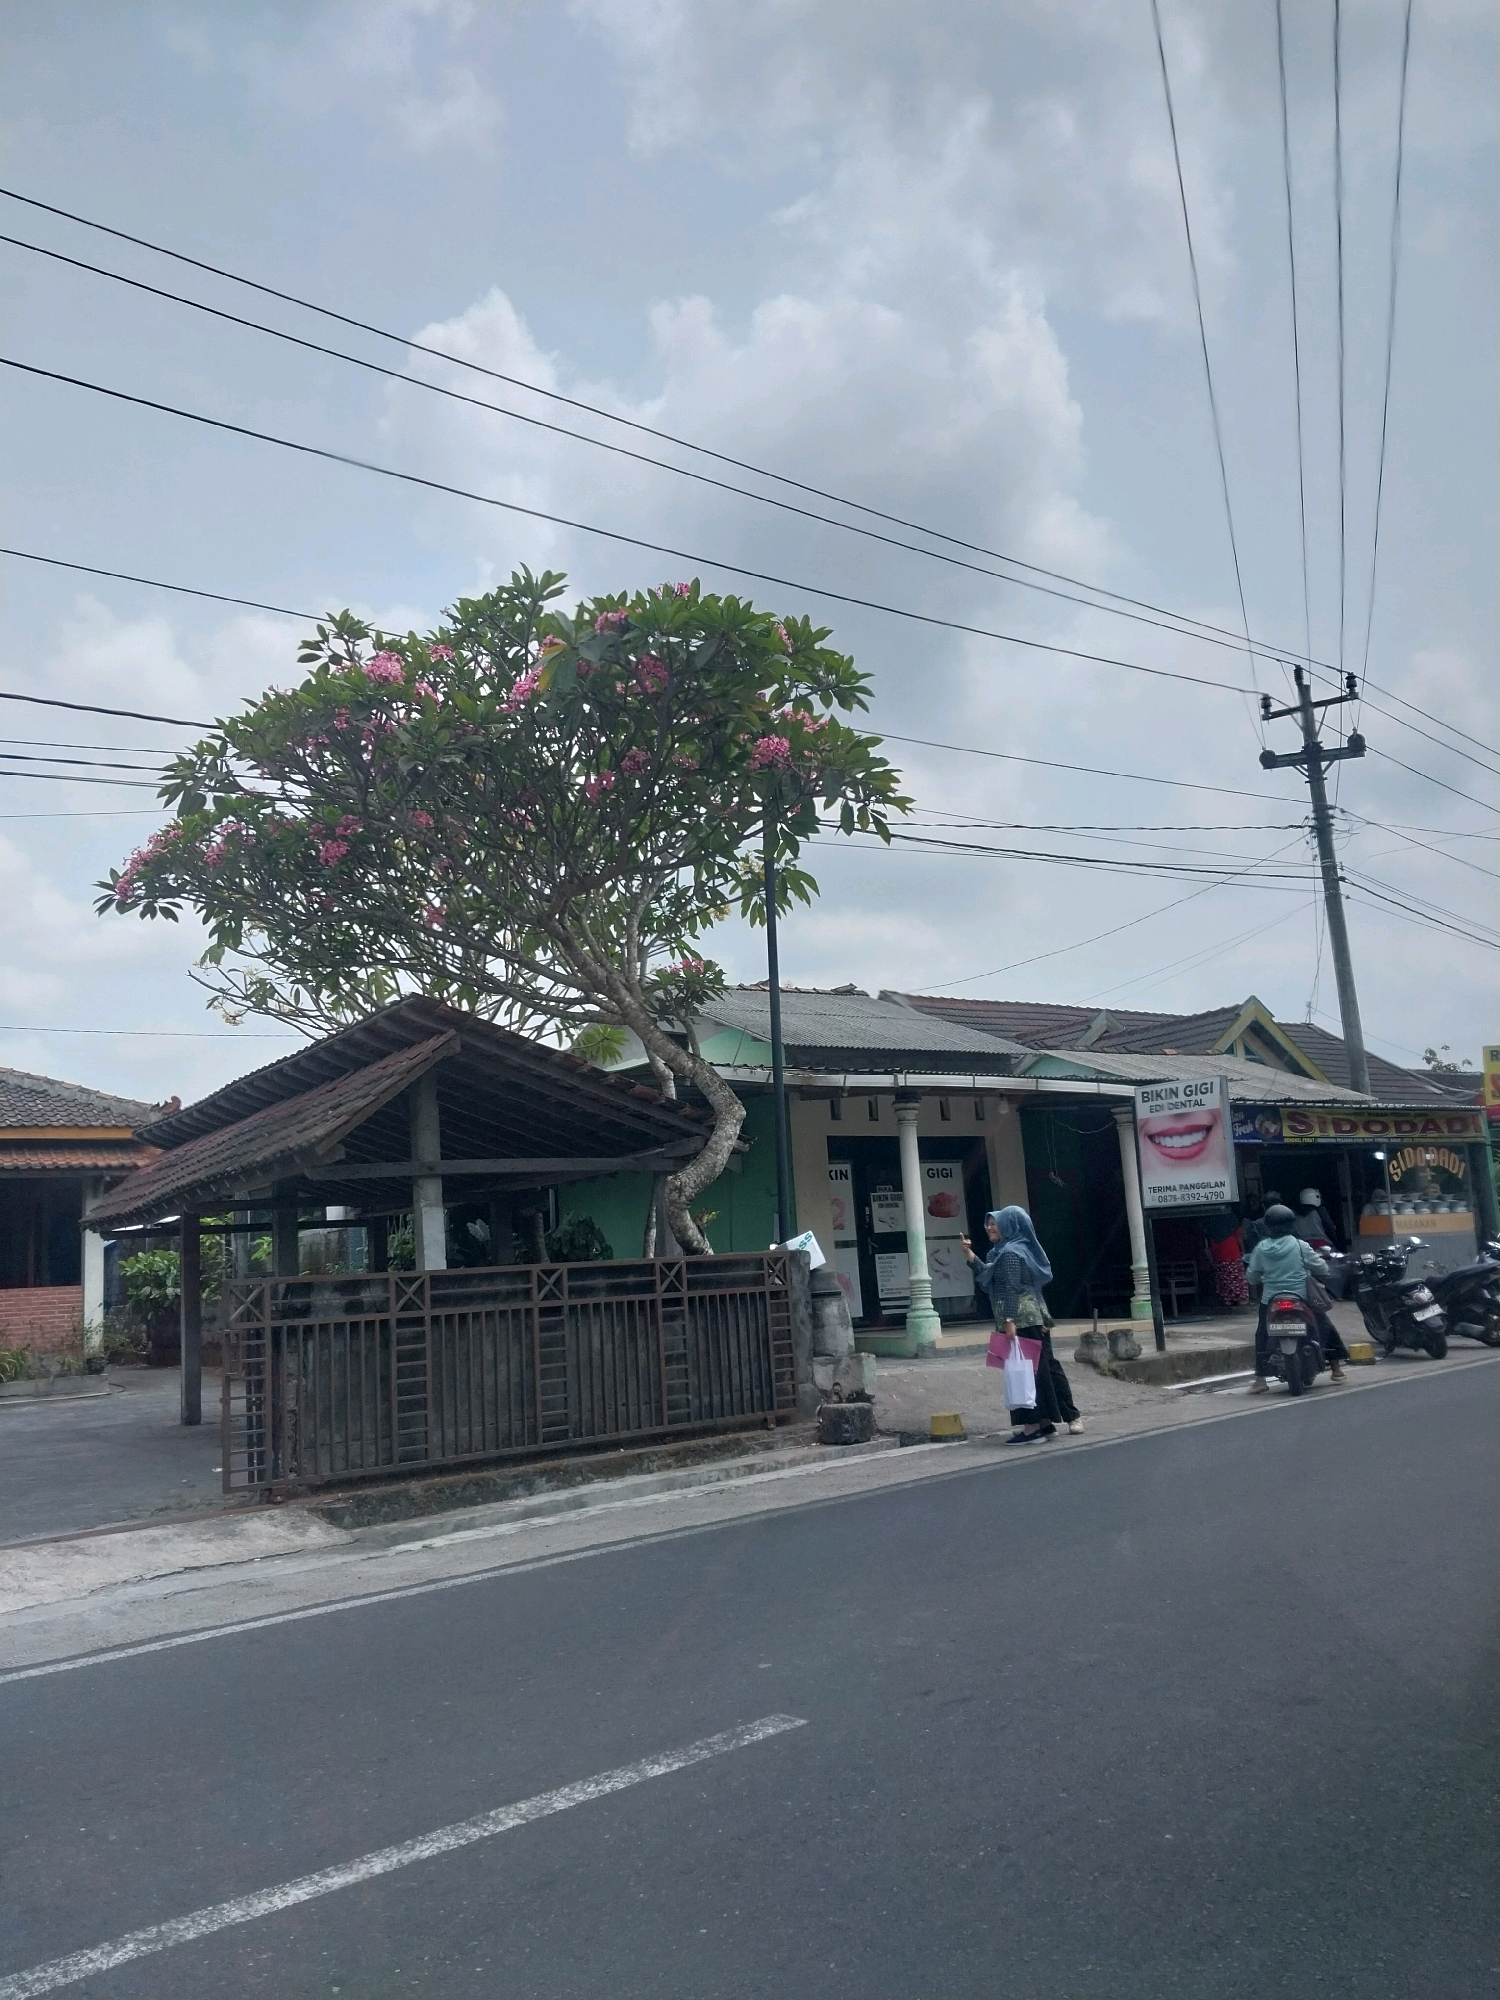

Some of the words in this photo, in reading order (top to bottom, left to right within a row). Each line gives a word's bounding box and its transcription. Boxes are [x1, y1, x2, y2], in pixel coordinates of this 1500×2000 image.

[1141, 1087, 1179, 1103] BIKIN
[1183, 1082, 1214, 1098] GIGI
[1149, 1104, 1165, 1114] EDI
[1168, 1098, 1206, 1111] DENTAL
[1286, 1110, 1482, 1137] SIDODADI
[926, 1168, 953, 1178] GIGI
[1148, 1185, 1178, 1194] TERIMA
[1179, 1181, 1226, 1192] PANGGILAN
[872, 1193, 888, 1203] BIKIN
[890, 1193, 903, 1201] GIGI
[1396, 1219, 1437, 1229] MASAKAN
